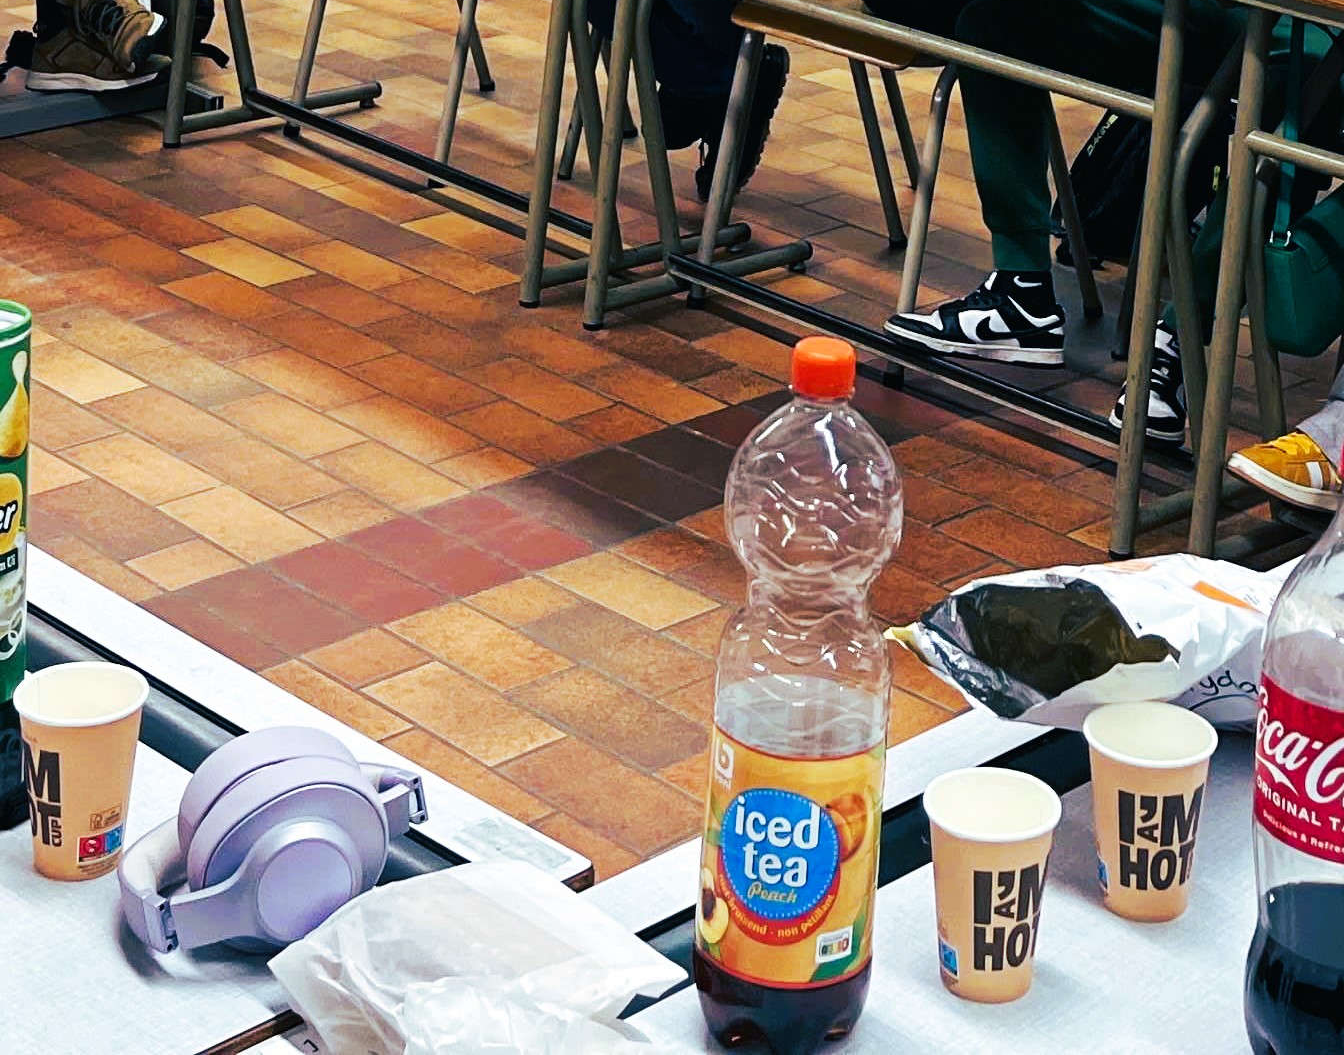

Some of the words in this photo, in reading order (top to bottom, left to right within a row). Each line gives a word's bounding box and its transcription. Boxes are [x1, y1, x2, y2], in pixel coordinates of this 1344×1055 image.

[735, 796, 821, 850] iced
[1256, 777, 1322, 826] ORIGINAL
[51, 819, 62, 847] CUP
[743, 843, 808, 888] tea
[1119, 837, 1195, 890] HOT
[747, 881, 798, 904] Peach
[777, 927, 799, 938] non
